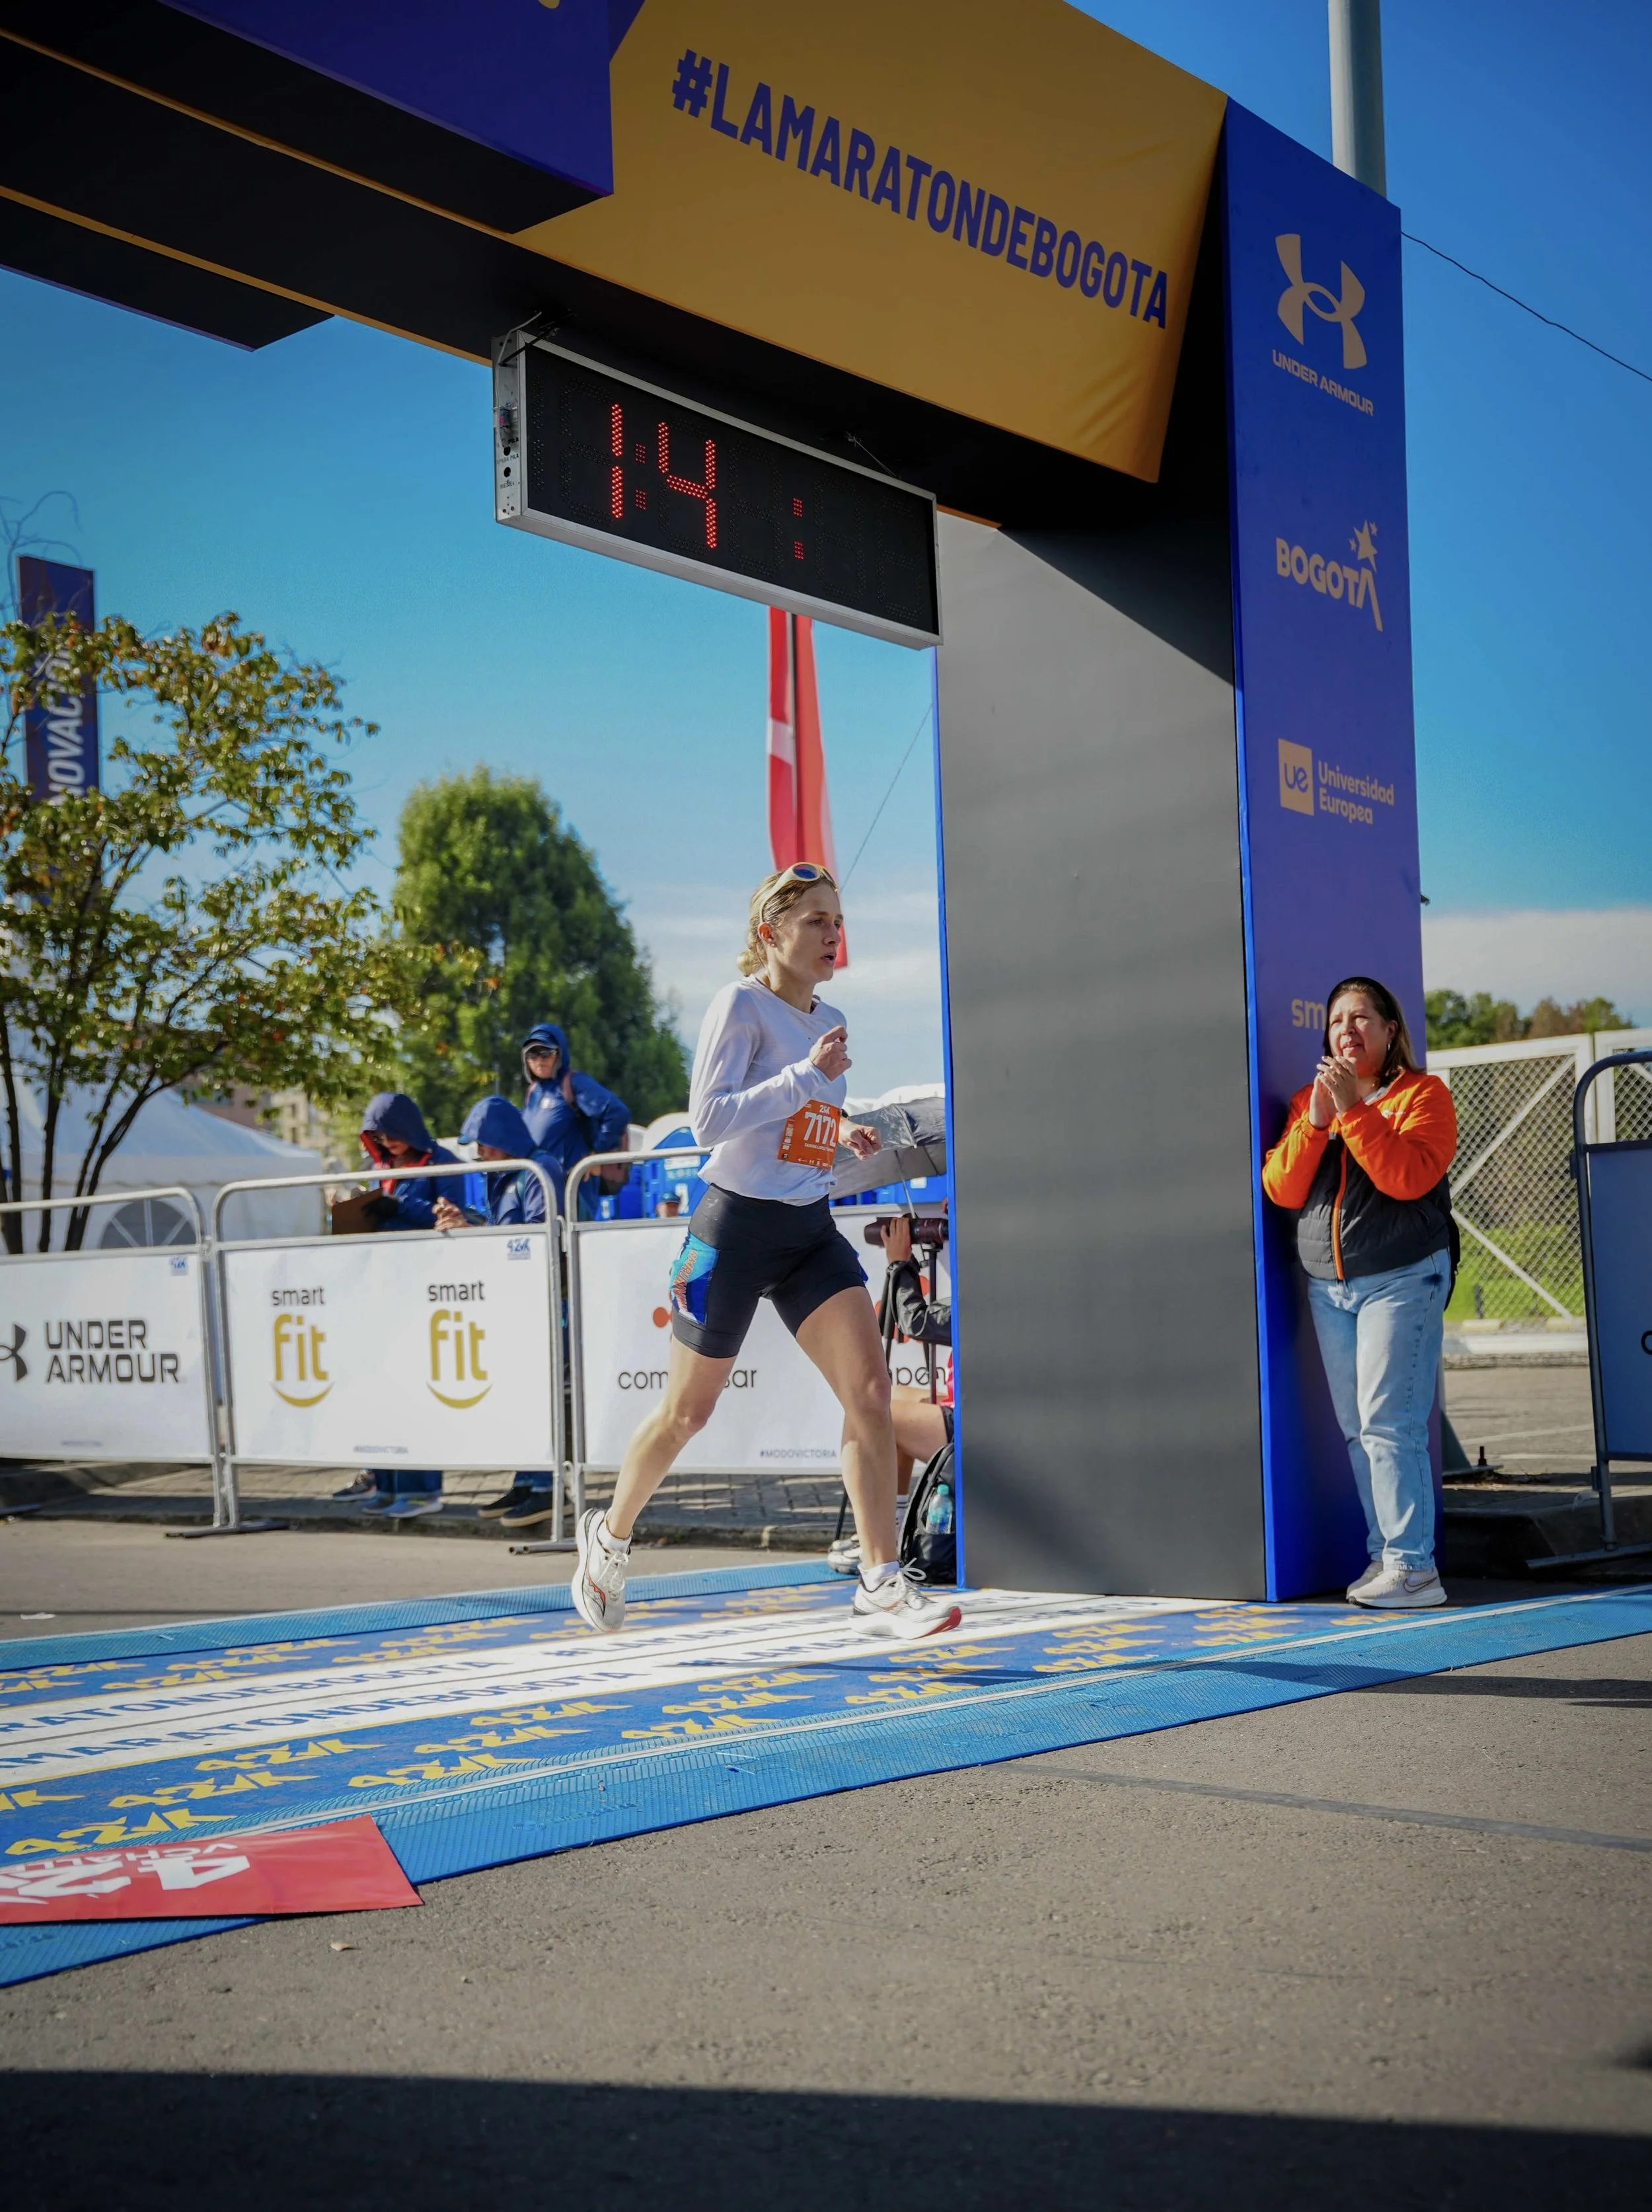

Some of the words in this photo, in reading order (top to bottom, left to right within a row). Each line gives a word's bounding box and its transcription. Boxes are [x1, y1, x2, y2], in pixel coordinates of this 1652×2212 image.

[672, 49, 1168, 329] #LAMARATONDEBOGOTA
[1272, 349, 1318, 388] UNDER
[1319, 377, 1374, 417] ARMOUR
[1318, 761, 1394, 807] Universidad
[1318, 787, 1373, 825] Europea
[804, 1112, 837, 1148] 7172
[272, 1286, 325, 1306] smart
[428, 1280, 486, 1302] smart
[46, 1320, 146, 1349] UNDER
[273, 1313, 328, 1381] fit
[430, 1309, 488, 1381] fit
[47, 1353, 179, 1383] ARMOUR
